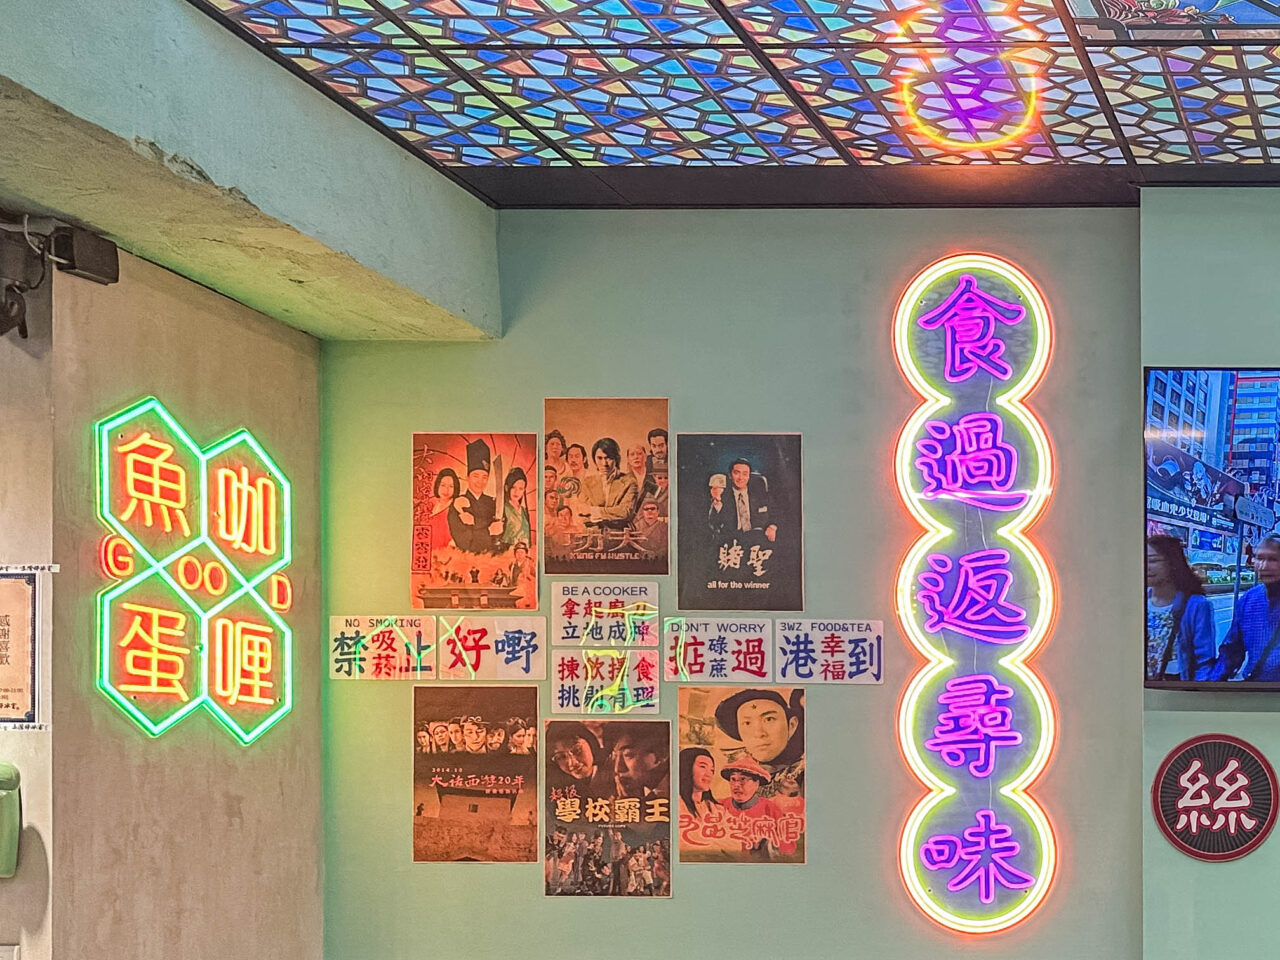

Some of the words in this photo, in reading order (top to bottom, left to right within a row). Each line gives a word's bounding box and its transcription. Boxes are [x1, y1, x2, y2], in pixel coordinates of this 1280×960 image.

[717, 539, 773, 577] 賭聖
[707, 581, 717, 589] all
[718, 581, 728, 589] for
[730, 581, 742, 589] the
[916, 273, 1036, 904] 食過返尋味
[562, 586, 581, 596] BE
[581, 586, 592, 596] A
[593, 586, 648, 597] COOKER
[345, 618, 361, 628] NO
[368, 618, 422, 628] SMOKING
[671, 622, 709, 633] DON'T
[716, 622, 766, 633] WORRY
[779, 622, 803, 632] 3WZ
[810, 622, 872, 633] FOOD&TEA
[555, 797, 670, 822] 學校霸王
[678, 811, 805, 850] 九品芝麻官
